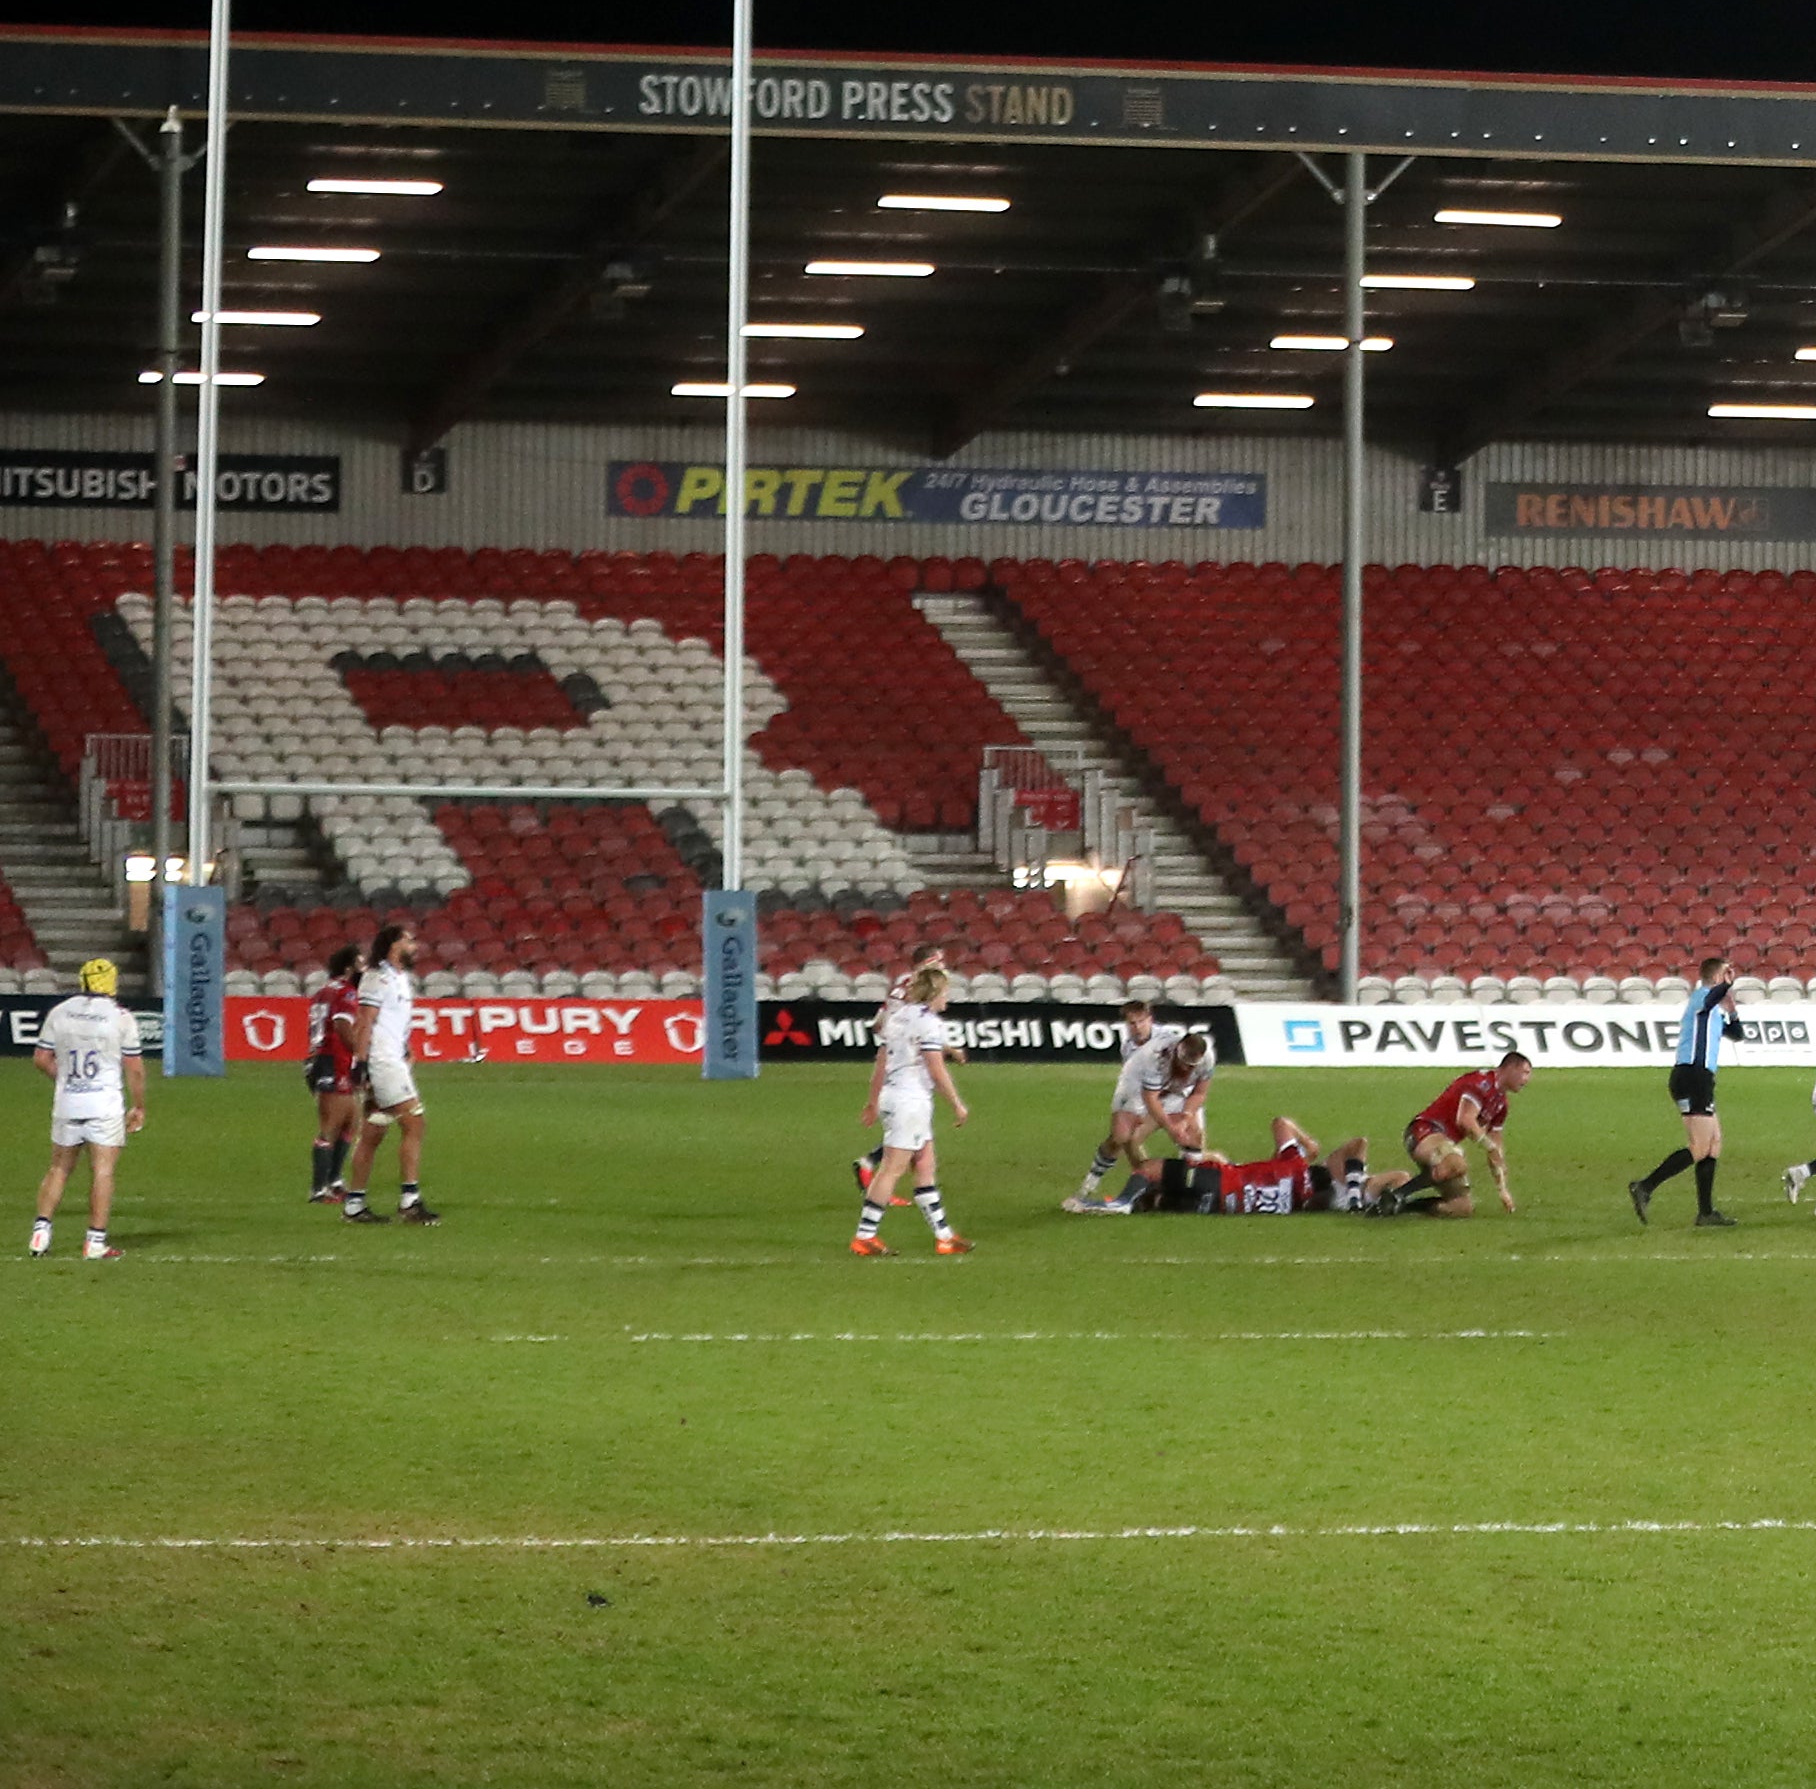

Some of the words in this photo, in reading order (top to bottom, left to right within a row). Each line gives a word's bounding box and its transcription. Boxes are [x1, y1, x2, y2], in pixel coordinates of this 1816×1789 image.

[638, 73, 831, 119] STOWFORD
[841, 79, 954, 124] PRESS
[965, 84, 1075, 126] STAND
[0, 466, 158, 501] ITSUBISH
[414, 470, 435, 493] D
[960, 492, 1222, 524] GLOUCESTER
[1433, 489, 1448, 511] E
[1515, 493, 1736, 530] RENISHAW
[186, 932, 212, 1057] Gallagher
[718, 936, 744, 1060] Gallagher
[410, 1008, 643, 1035] RTPURY
[817, 1019, 1044, 1050] MITBISHI
[1053, 1021, 1213, 1050] MOTRS
[1340, 1020, 1681, 1054] PAVESTONE
[1743, 1022, 1808, 1043] bpe
[423, 1038, 636, 1057] LEGE
[67, 1049, 99, 1080] 16
